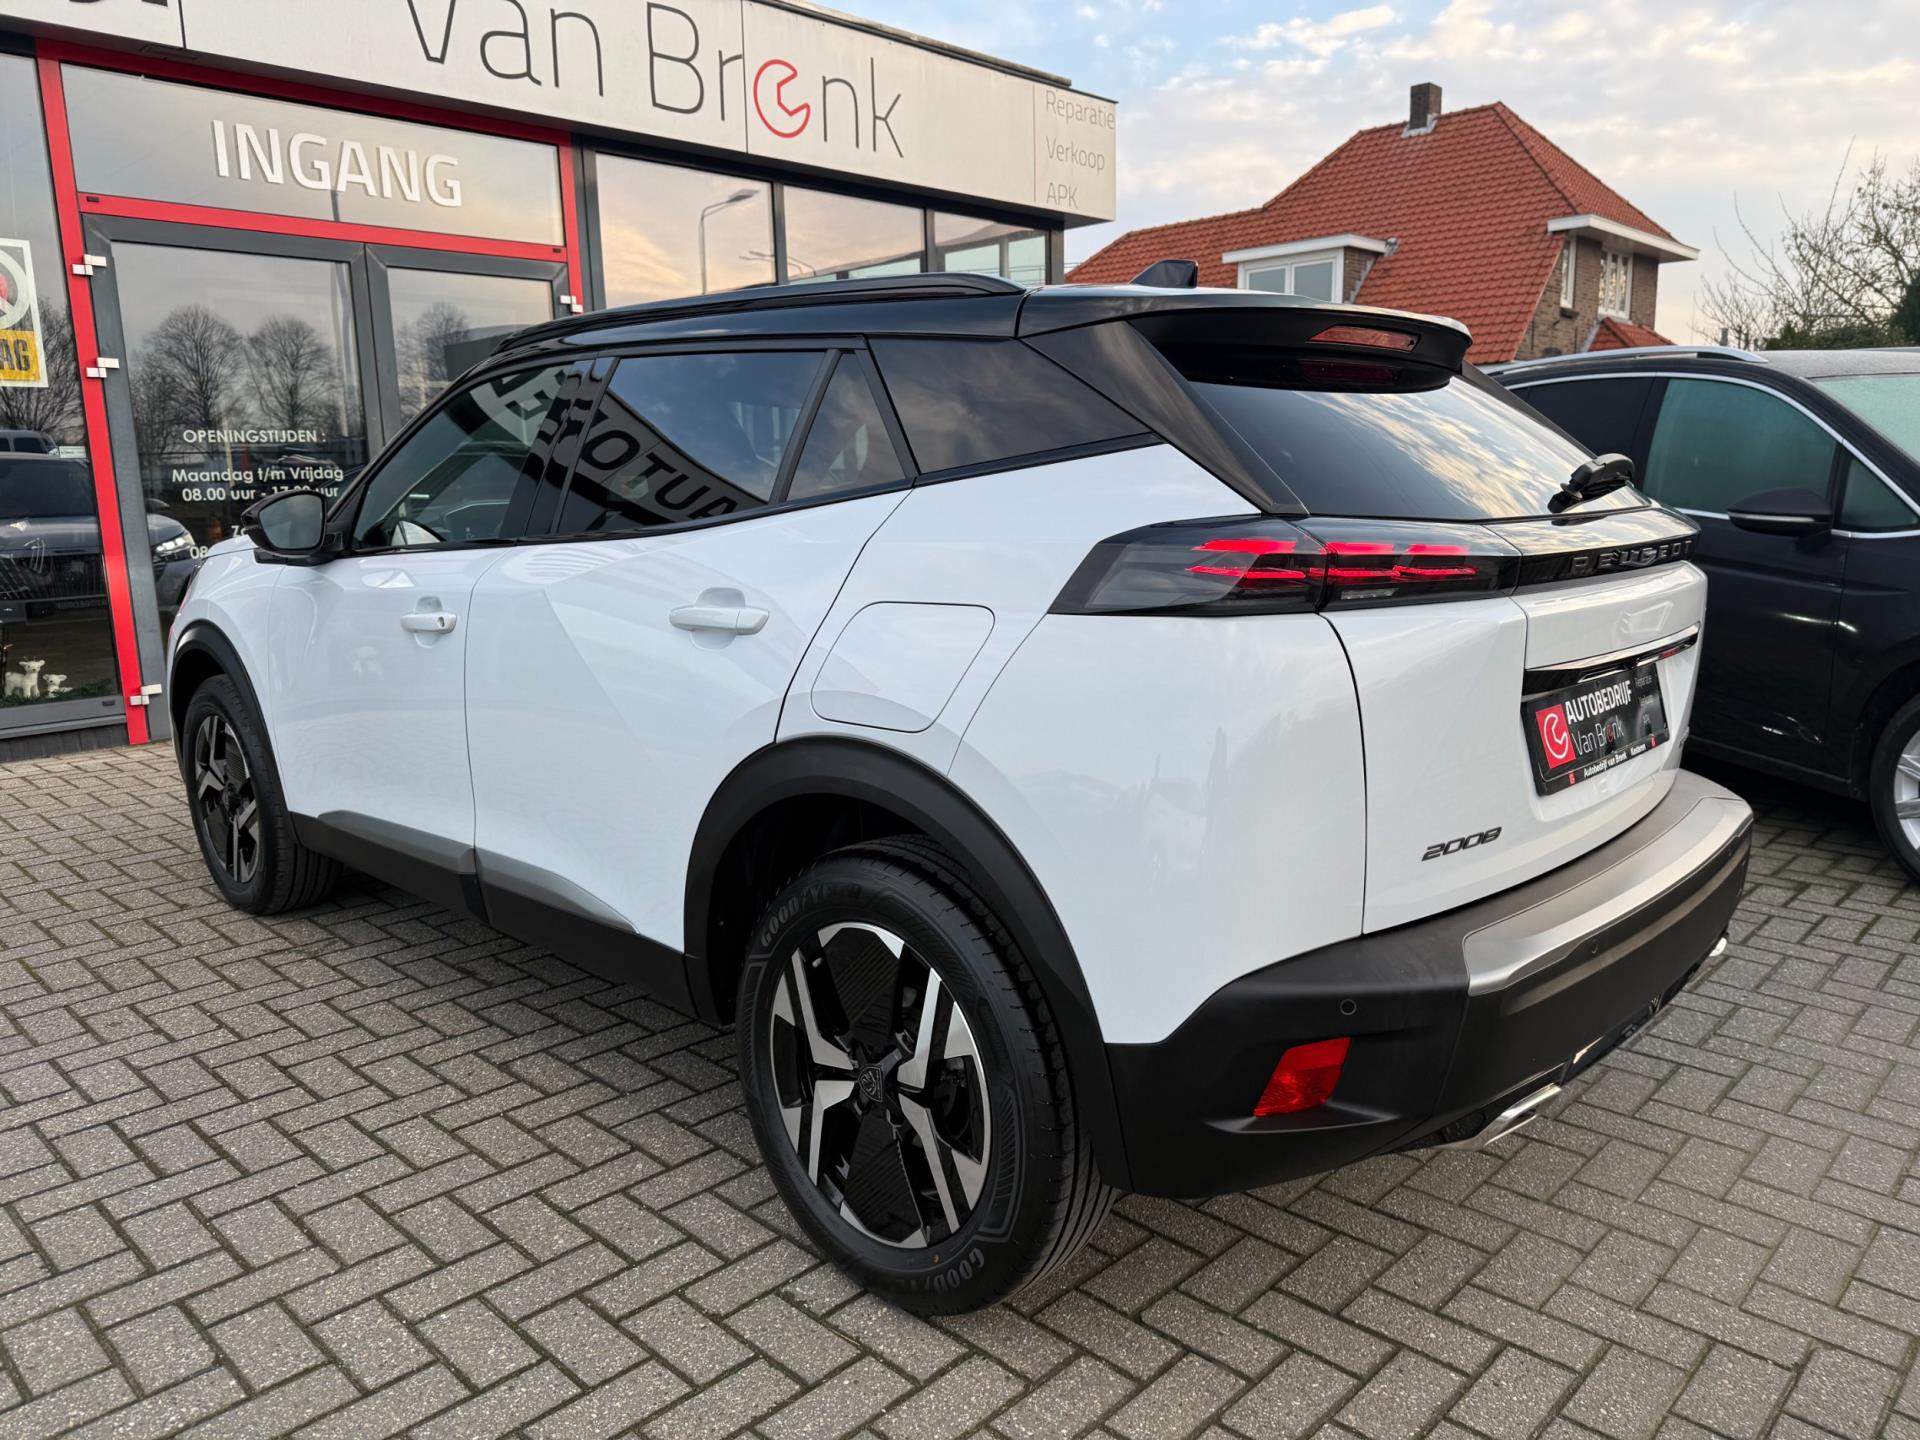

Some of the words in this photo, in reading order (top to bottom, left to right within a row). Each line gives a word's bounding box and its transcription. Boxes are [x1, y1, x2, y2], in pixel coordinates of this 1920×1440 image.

[1045, 89, 1116, 130] Reparatie
[212, 119, 463, 207] INGANG
[1045, 135, 1105, 176] Verkoop
[1045, 181, 1079, 209] APK
[182, 429, 318, 443] OPENINGSTIJDEN
[172, 469, 254, 483] Maandag
[257, 467, 286, 482] t/m
[289, 466, 344, 482] Vrijdag
[182, 487, 226, 501] 08.00
[230, 489, 256, 500] uur
[1565, 680, 1633, 725] AUTOBEDRIJF
[1571, 730, 1598, 756] Van
[1421, 826, 1502, 861] 2008
